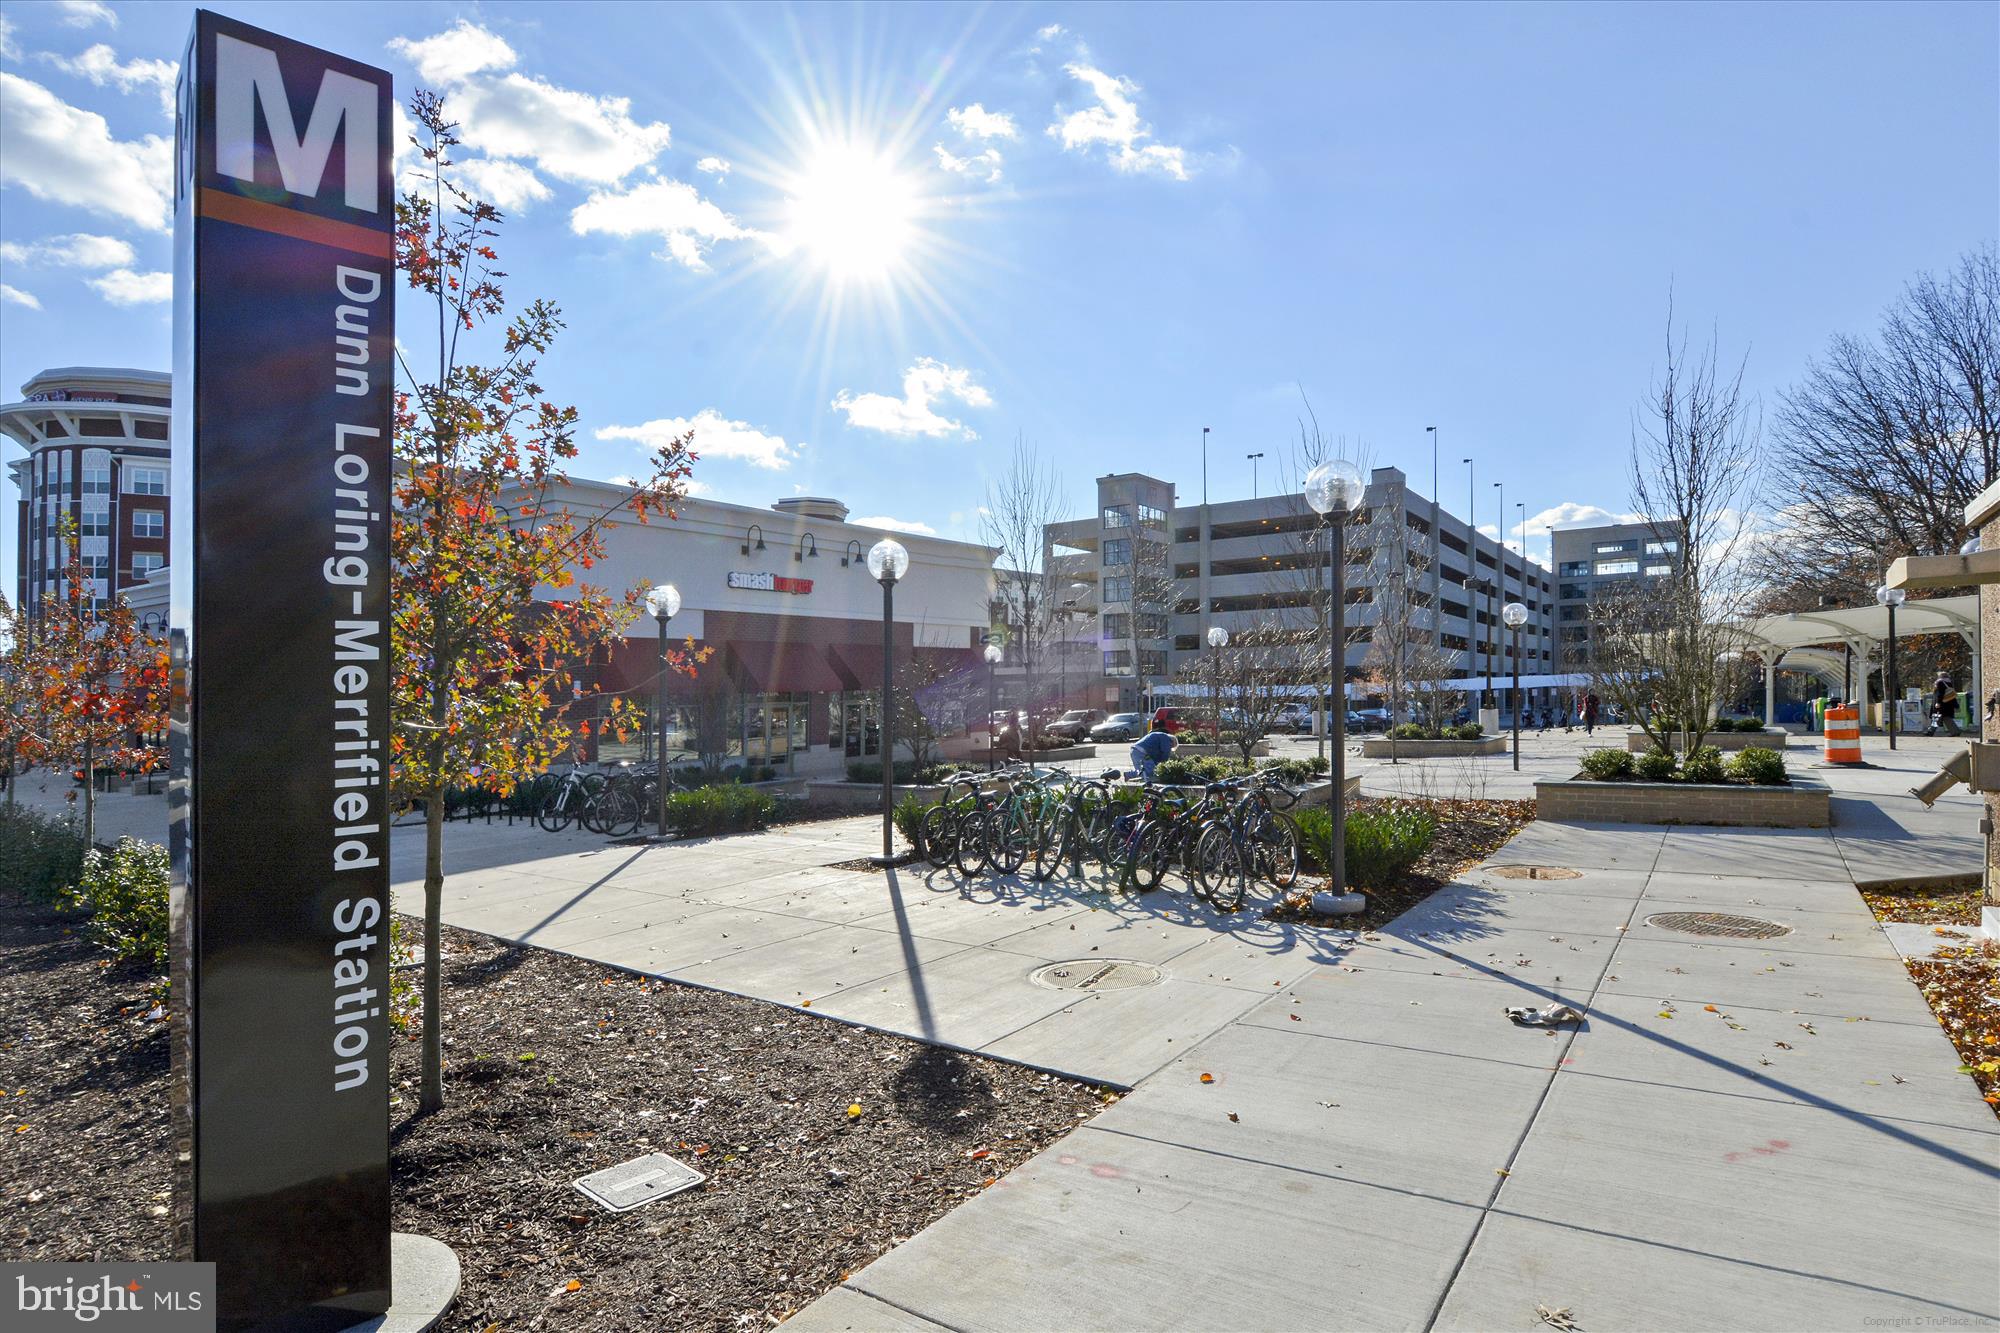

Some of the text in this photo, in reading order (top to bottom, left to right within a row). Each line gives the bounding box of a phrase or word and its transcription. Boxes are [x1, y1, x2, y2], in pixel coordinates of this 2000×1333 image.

[216, 32, 378, 214] M
[323, 264, 381, 1092] Dunn Loring-Merrifield Station
